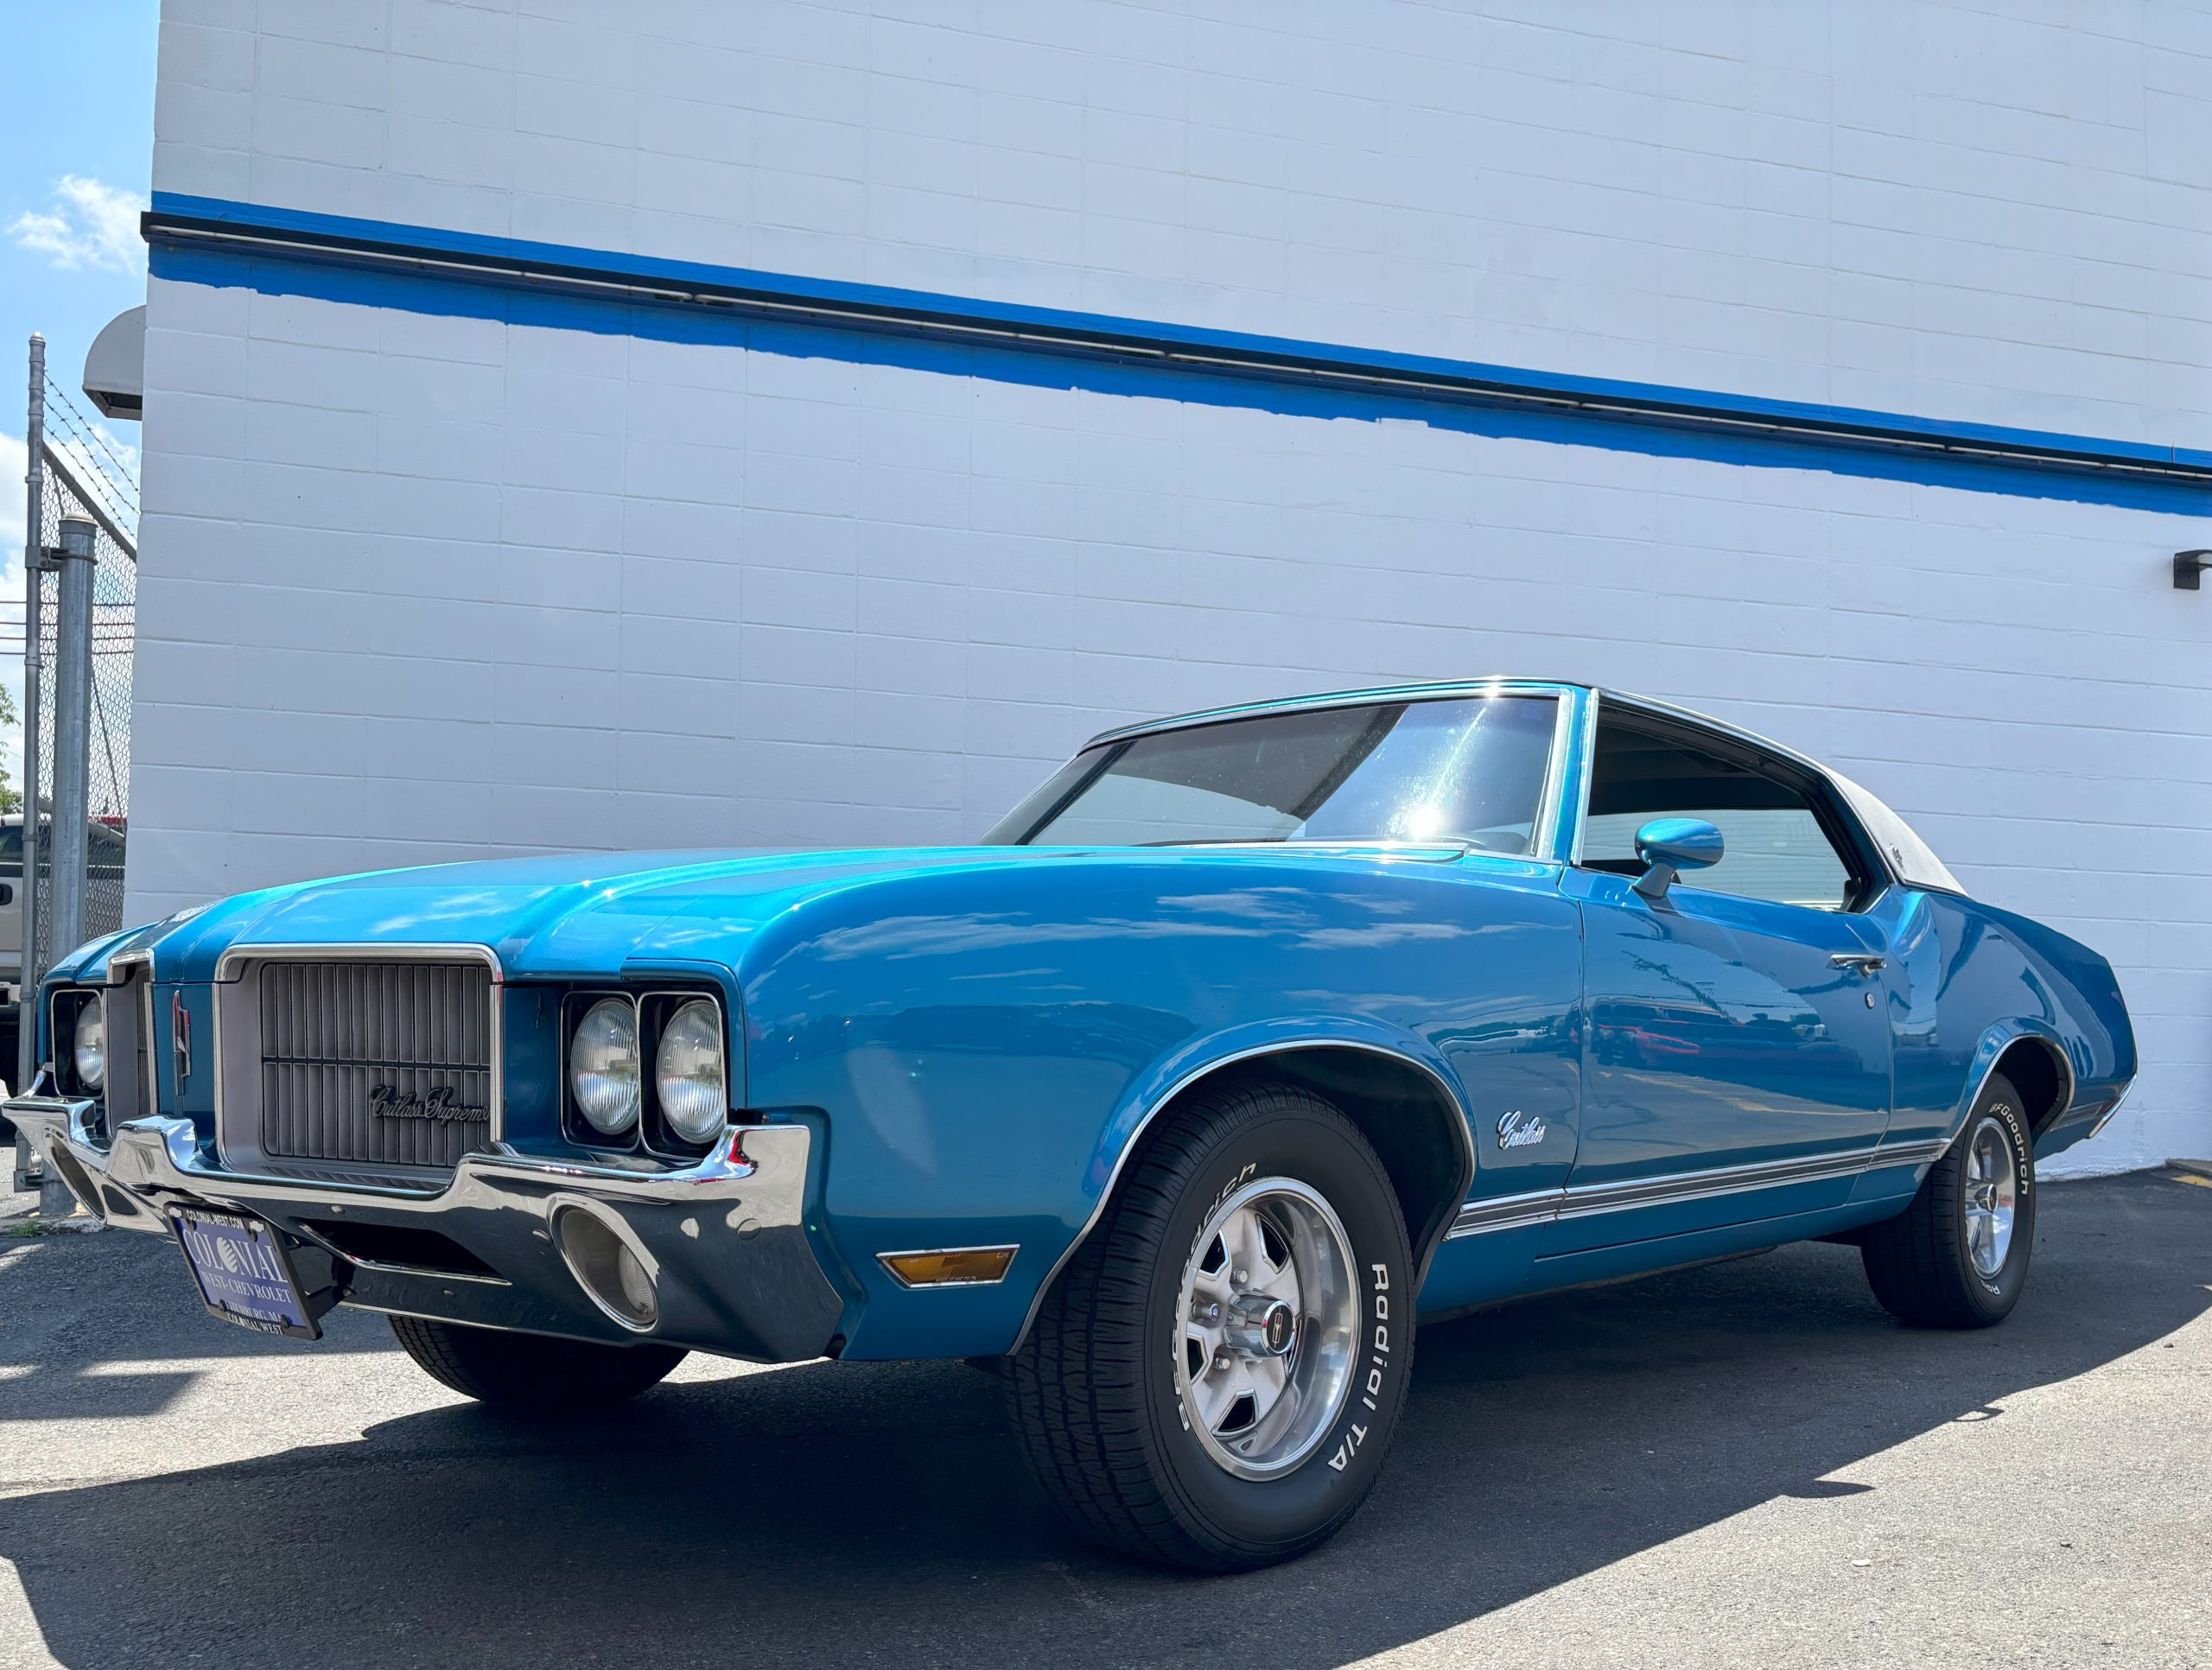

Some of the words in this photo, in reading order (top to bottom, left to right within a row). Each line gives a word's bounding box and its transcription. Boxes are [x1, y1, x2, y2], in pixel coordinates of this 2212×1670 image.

[371, 1085, 423, 1119] Cutlass
[424, 1086, 491, 1127] Supreme
[1497, 1110, 1546, 1150] Cutlass
[1989, 1102, 2029, 1196] BFGoodrich
[182, 1229, 289, 1283] COLONIAL
[1363, 1264, 1389, 1412] Radial
[1328, 1424, 1368, 1471] T/A
